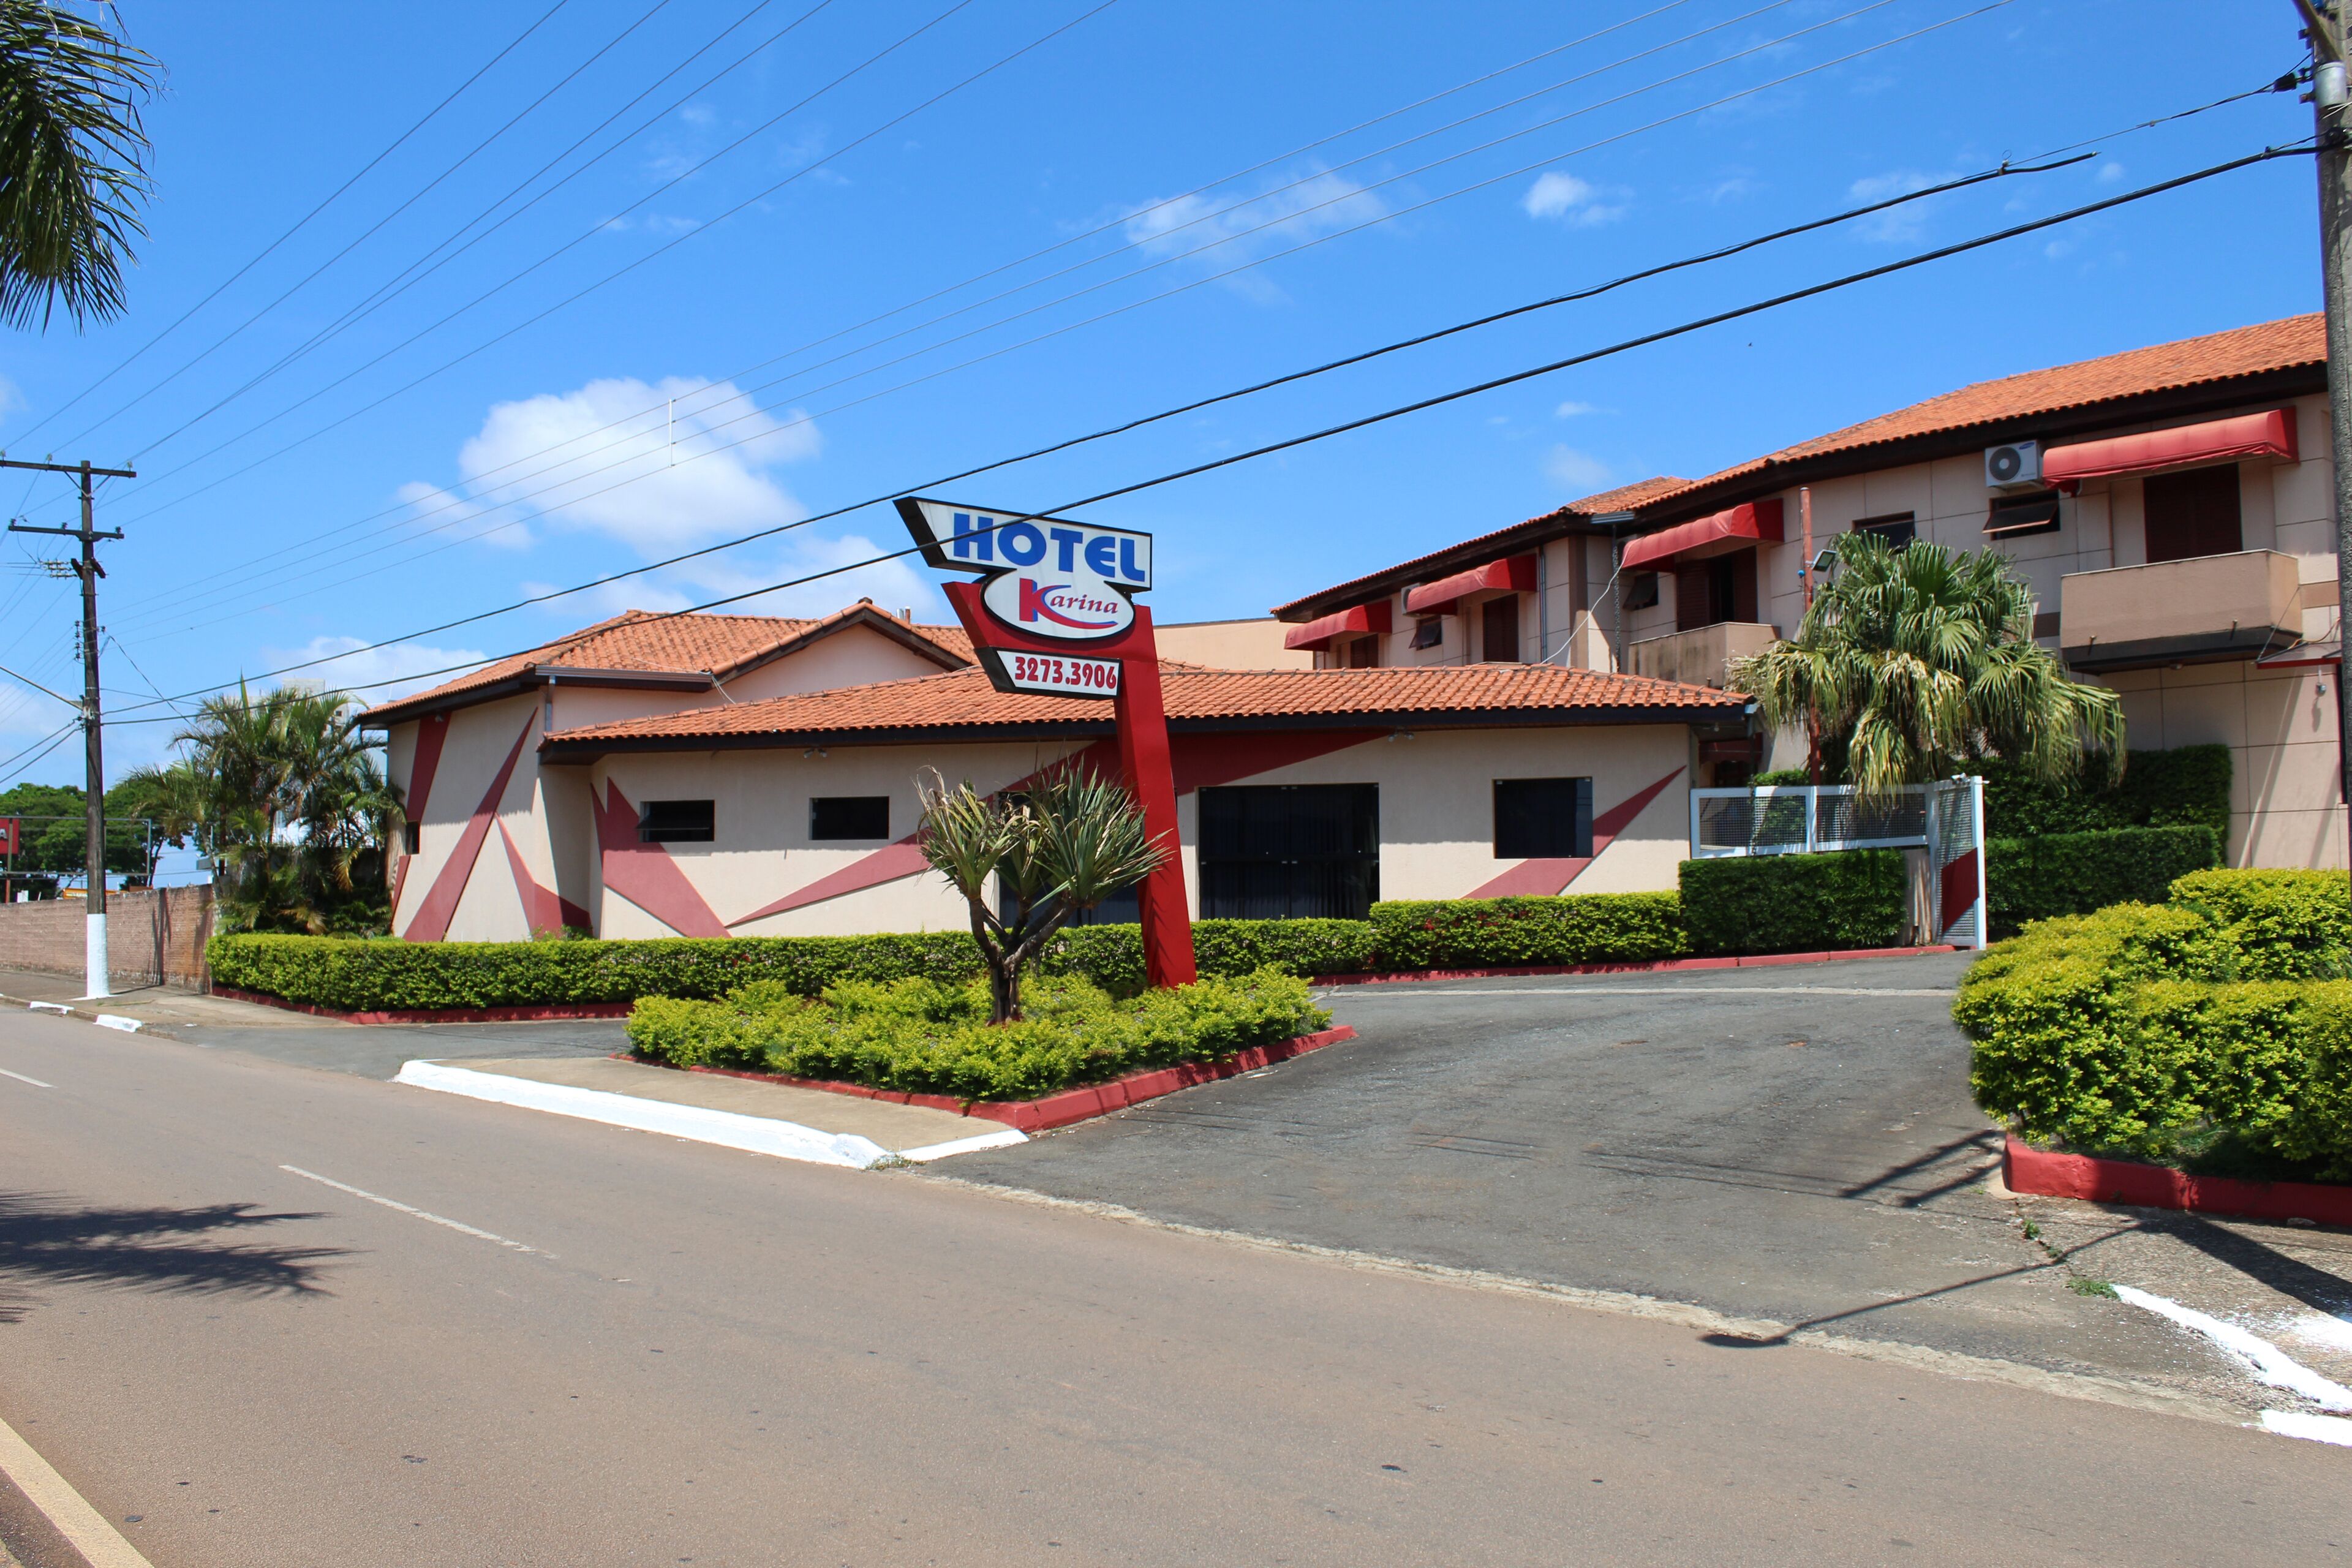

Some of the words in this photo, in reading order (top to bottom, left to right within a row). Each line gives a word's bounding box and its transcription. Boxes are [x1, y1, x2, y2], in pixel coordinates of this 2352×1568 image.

[954, 513, 1145, 582] HOTEL
[1019, 578, 1118, 629] Karina
[1015, 656, 1117, 689] 3273.3906
